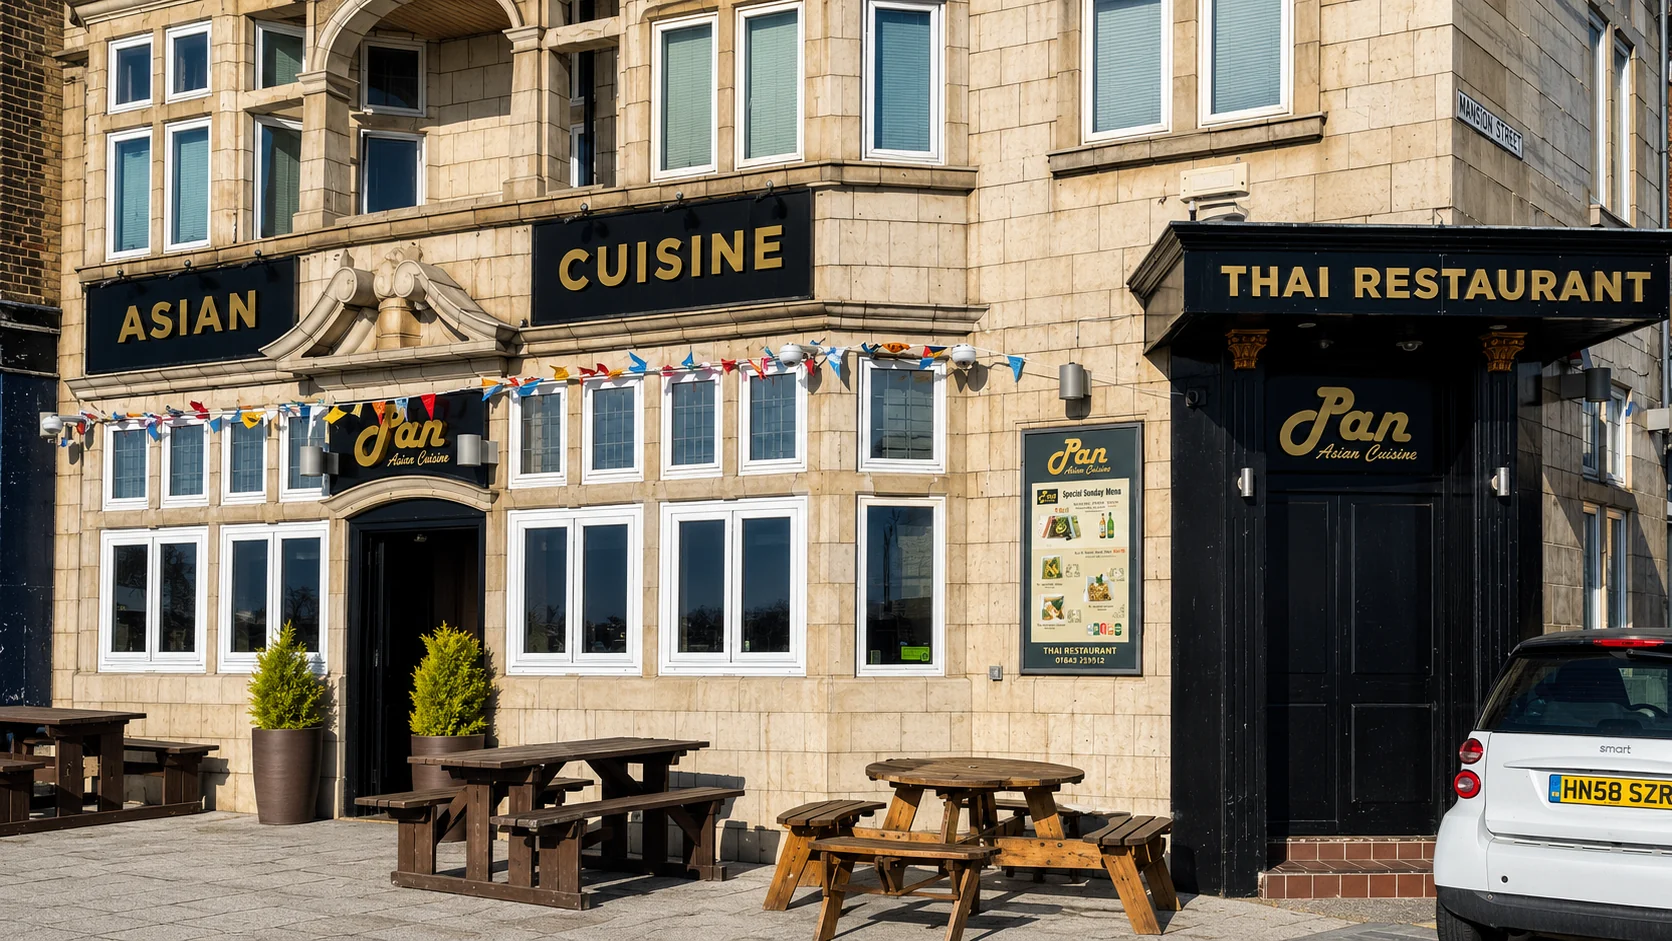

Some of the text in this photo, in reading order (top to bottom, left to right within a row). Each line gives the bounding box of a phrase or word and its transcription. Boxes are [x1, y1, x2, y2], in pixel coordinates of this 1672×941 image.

[1459, 94, 1522, 154] MANSION STREET
[558, 225, 785, 291] CUISINE
[1220, 265, 1652, 303] THAI RESTAURANT
[117, 289, 257, 344] ASIAN
[354, 403, 446, 468] Pan
[1279, 386, 1412, 457] Pan
[386, 450, 450, 467] Asian Cuisine
[1047, 438, 1108, 475] Pan
[1315, 443, 1418, 463] Asian Cuisine
[1083, 488, 1104, 498] Sunday
[1043, 646, 1117, 655] THAI RESTAURANT
[1599, 745, 1632, 755] smart
[1563, 779, 1672, 805] HN58 SZR
